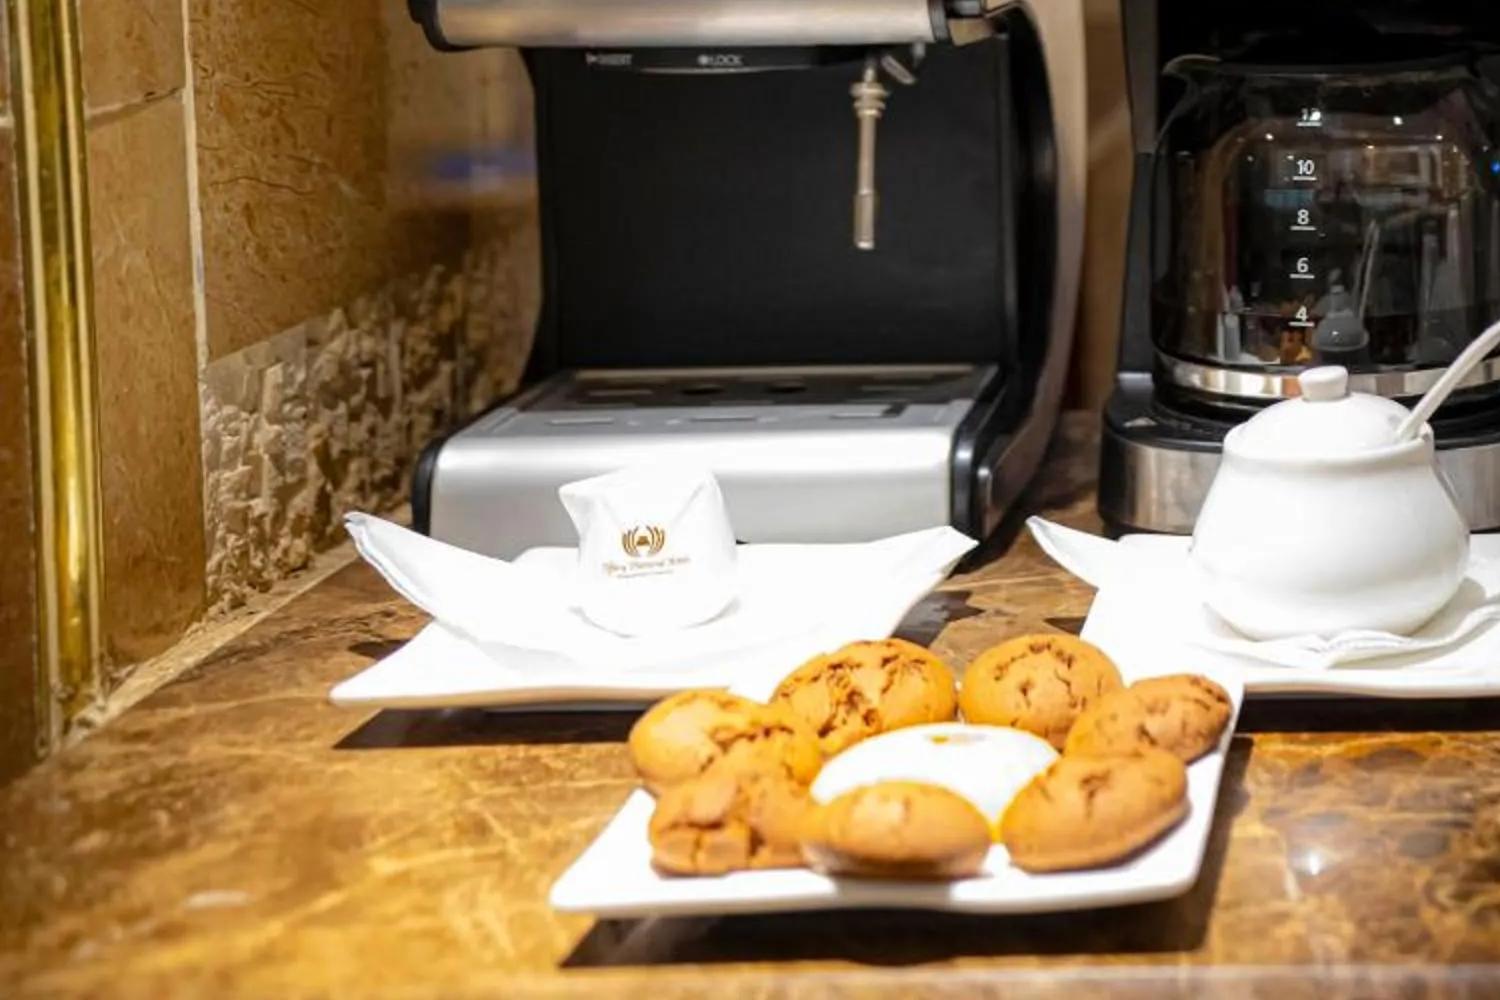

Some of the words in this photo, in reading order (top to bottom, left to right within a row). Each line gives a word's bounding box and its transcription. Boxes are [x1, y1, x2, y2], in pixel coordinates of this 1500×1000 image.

[712, 54, 744, 66] LOCK
[1296, 160, 1315, 175] 10
[1296, 209, 1310, 226] 8
[1296, 257, 1309, 274] 6
[1295, 305, 1308, 322] 4
